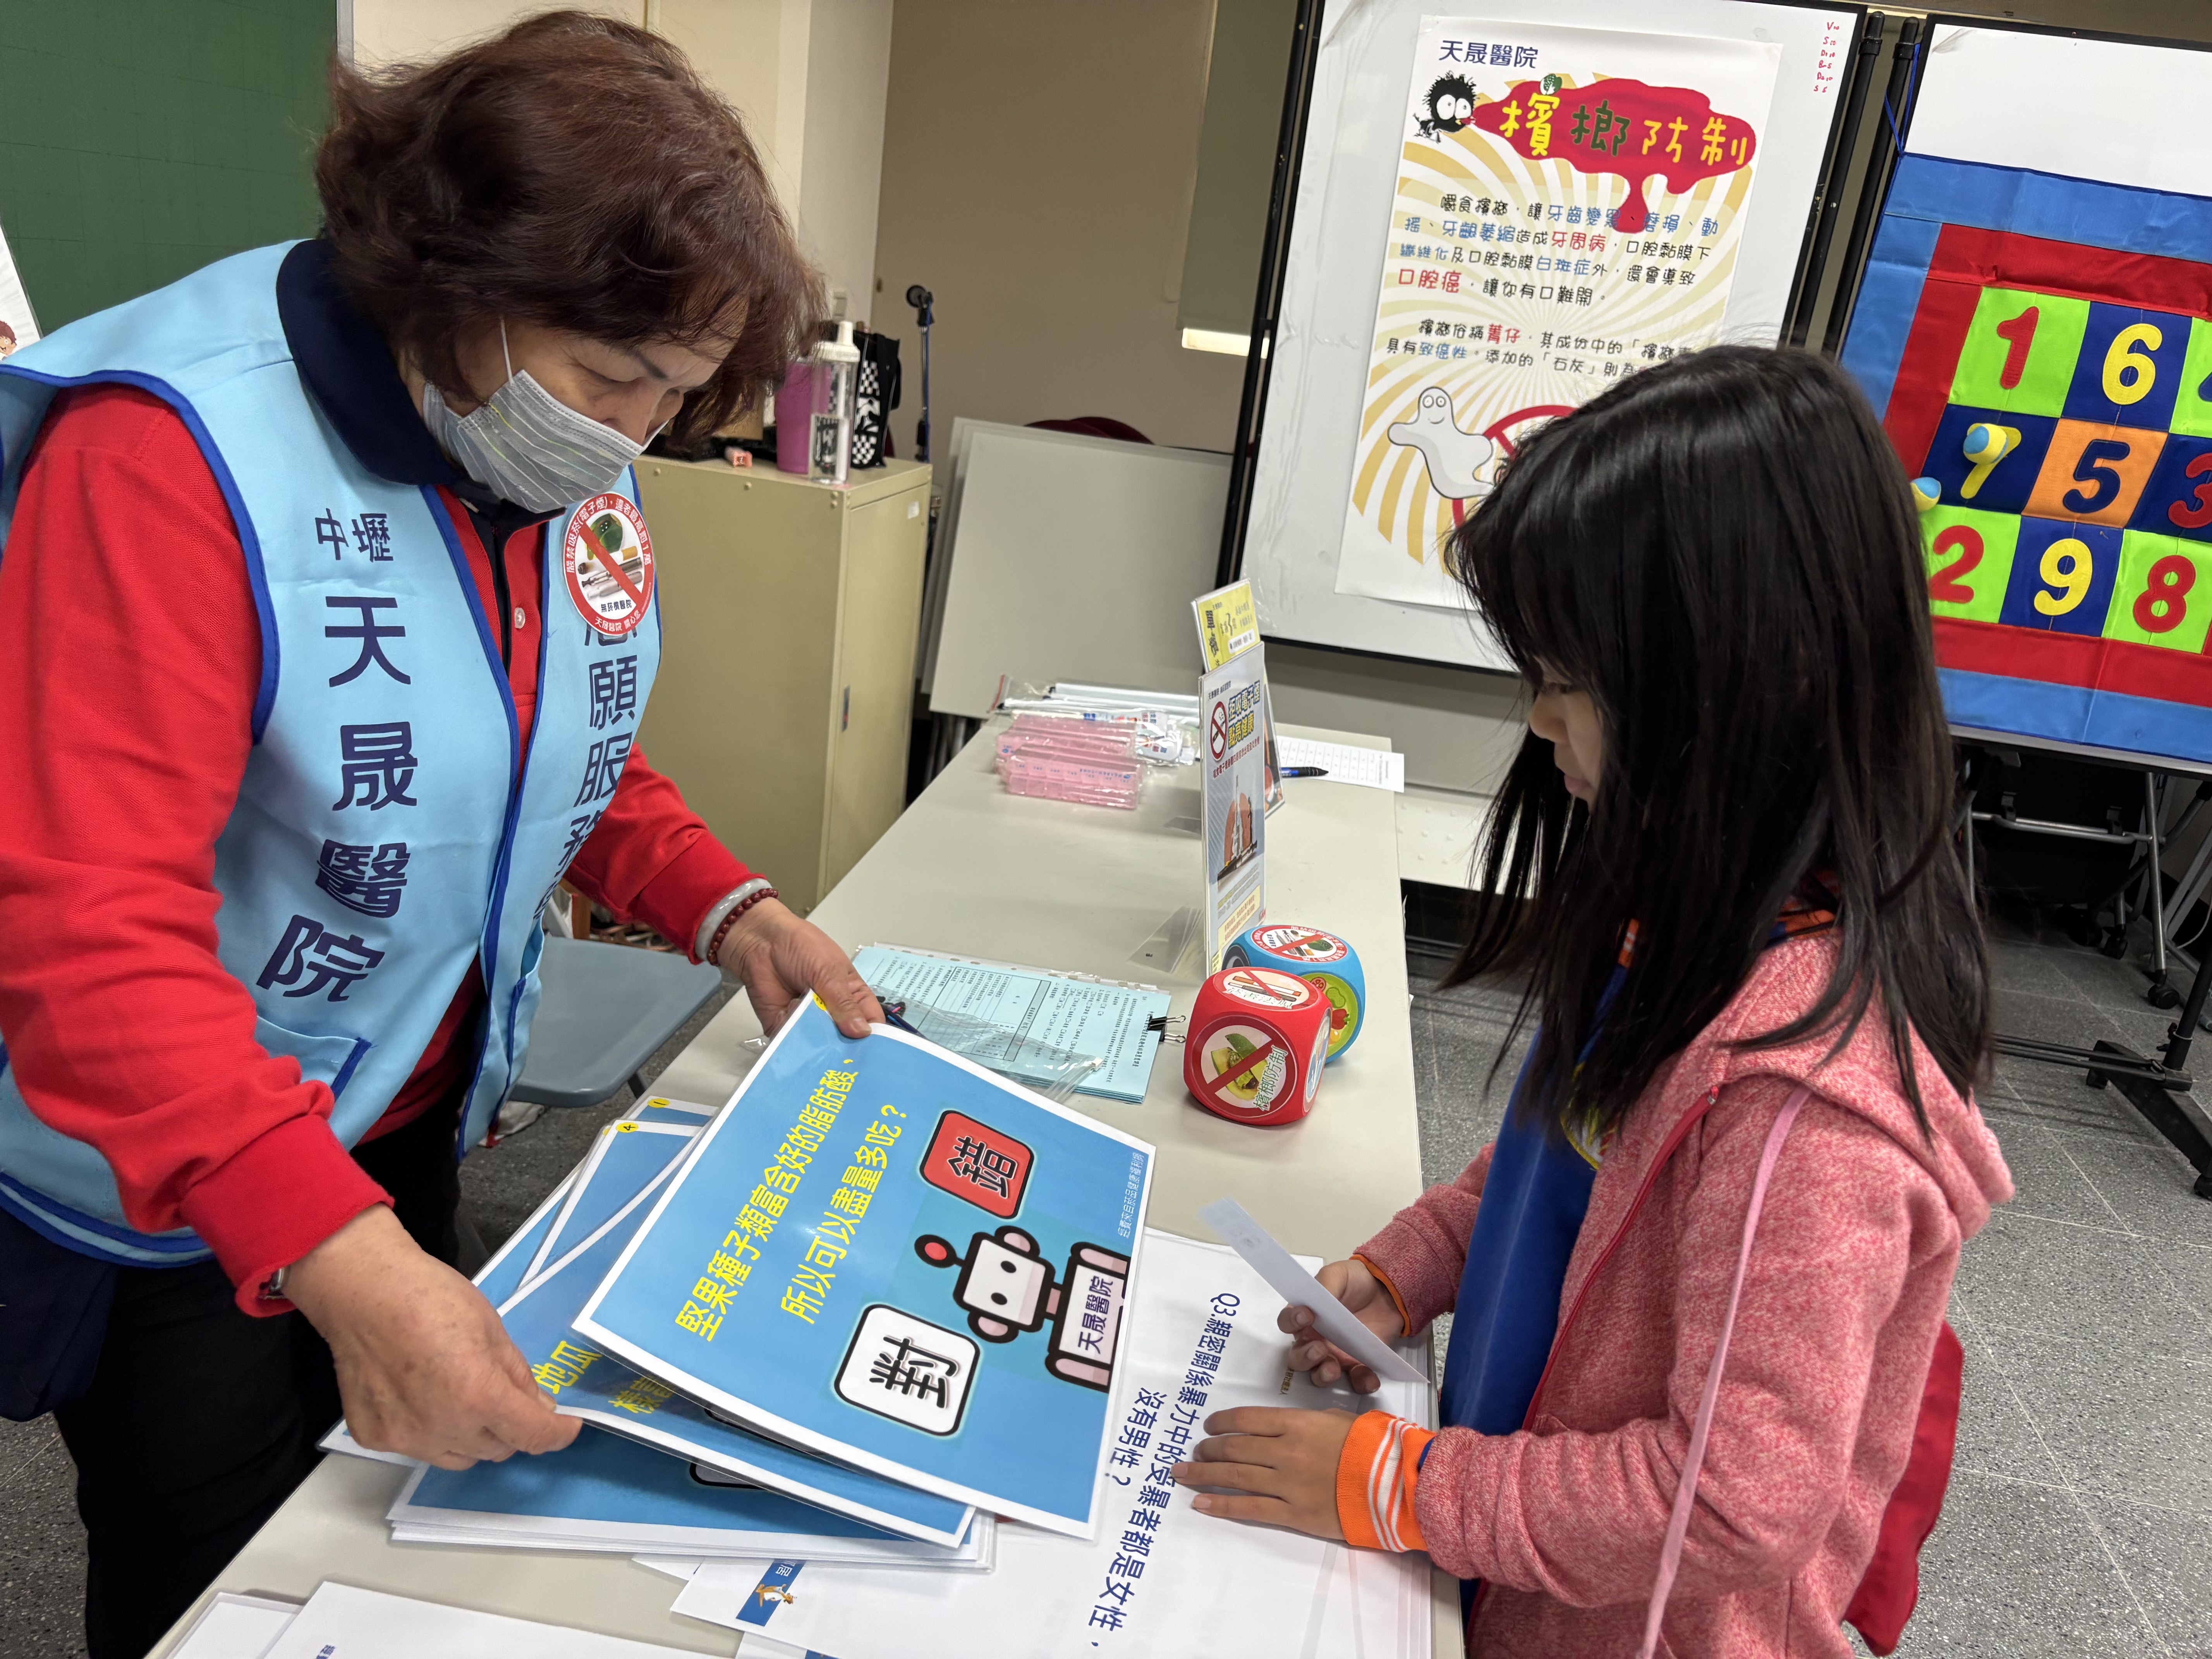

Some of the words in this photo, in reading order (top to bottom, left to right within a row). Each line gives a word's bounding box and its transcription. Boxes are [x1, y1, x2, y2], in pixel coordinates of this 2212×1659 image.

[1439, 40, 1539, 69] 天晟醫院
[1823, 36, 1829, 45] S
[1499, 93, 1747, 165] 檳榔防制
[1997, 306, 2039, 389] 1
[2102, 323, 2162, 405] 6
[2062, 439, 2130, 514] 5
[2168, 453, 2212, 528] 3
[316, 508, 393, 562] 中壢
[1930, 524, 1984, 603] 2
[2034, 538, 2092, 616] 9
[2133, 555, 2196, 633] 8
[256, 596, 418, 1003] 天晟醫院
[1253, 1044, 1288, 1111] 檳榔防制
[946, 1135, 1018, 1200] 錯
[781, 1104, 908, 1322] 所以可以盡量多吃？
[1077, 1276, 1113, 1353] 天晟醫院
[871, 1336, 960, 1410] 對
[1105, 1387, 1168, 1487] 沒有男性？
